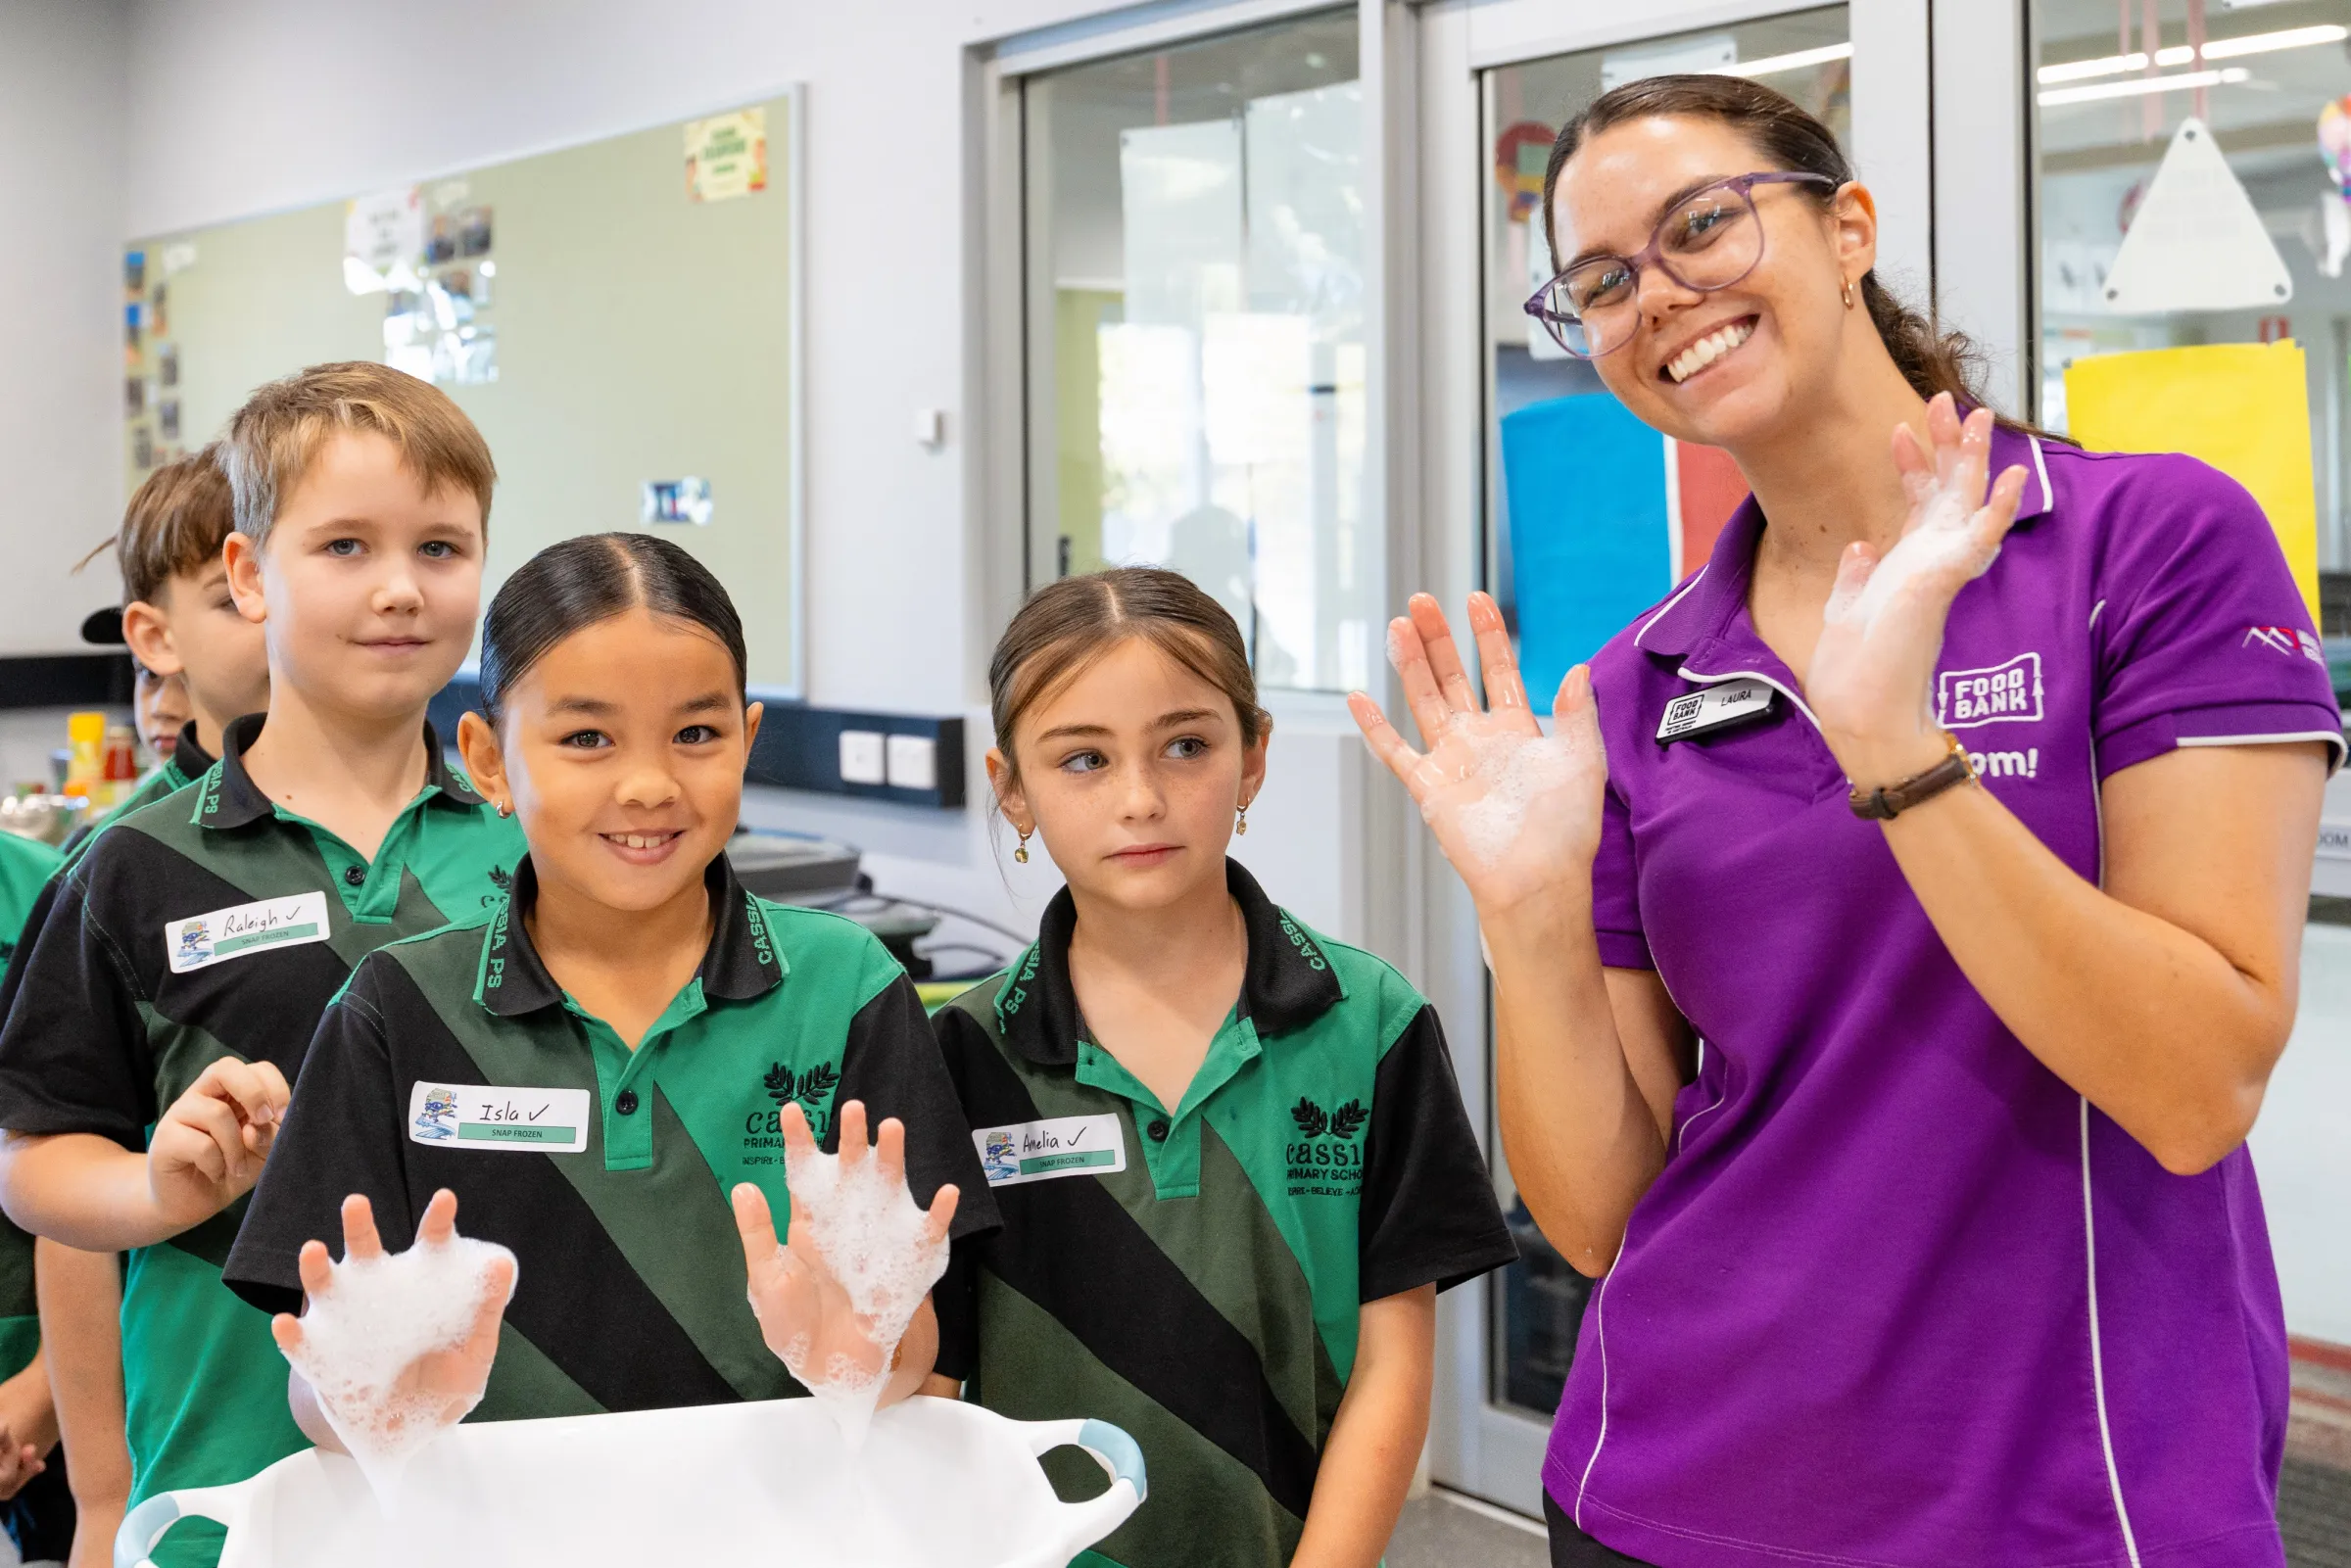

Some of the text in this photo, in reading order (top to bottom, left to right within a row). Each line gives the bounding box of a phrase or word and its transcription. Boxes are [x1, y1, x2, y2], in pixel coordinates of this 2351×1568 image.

[1954, 668, 2025, 700] FOOD
[1676, 699, 1699, 712] FOOD
[1720, 689, 1752, 706] LAURA
[1954, 687, 2029, 719] BANK
[1672, 707, 1697, 721] BANK
[1966, 747, 2039, 779] om!
[224, 909, 278, 937] Raleigh
[241, 930, 289, 946] SNAP FROZEN
[487, 958, 505, 989] PS
[1004, 986, 1028, 1015] PS
[479, 1101, 519, 1121] Isla
[492, 1128, 543, 1138] SNAP FROZEN
[744, 1137, 786, 1149] PRIMA
[1023, 1130, 1060, 1153] Amelia
[1039, 1157, 1085, 1168] SNAP FROZEN
